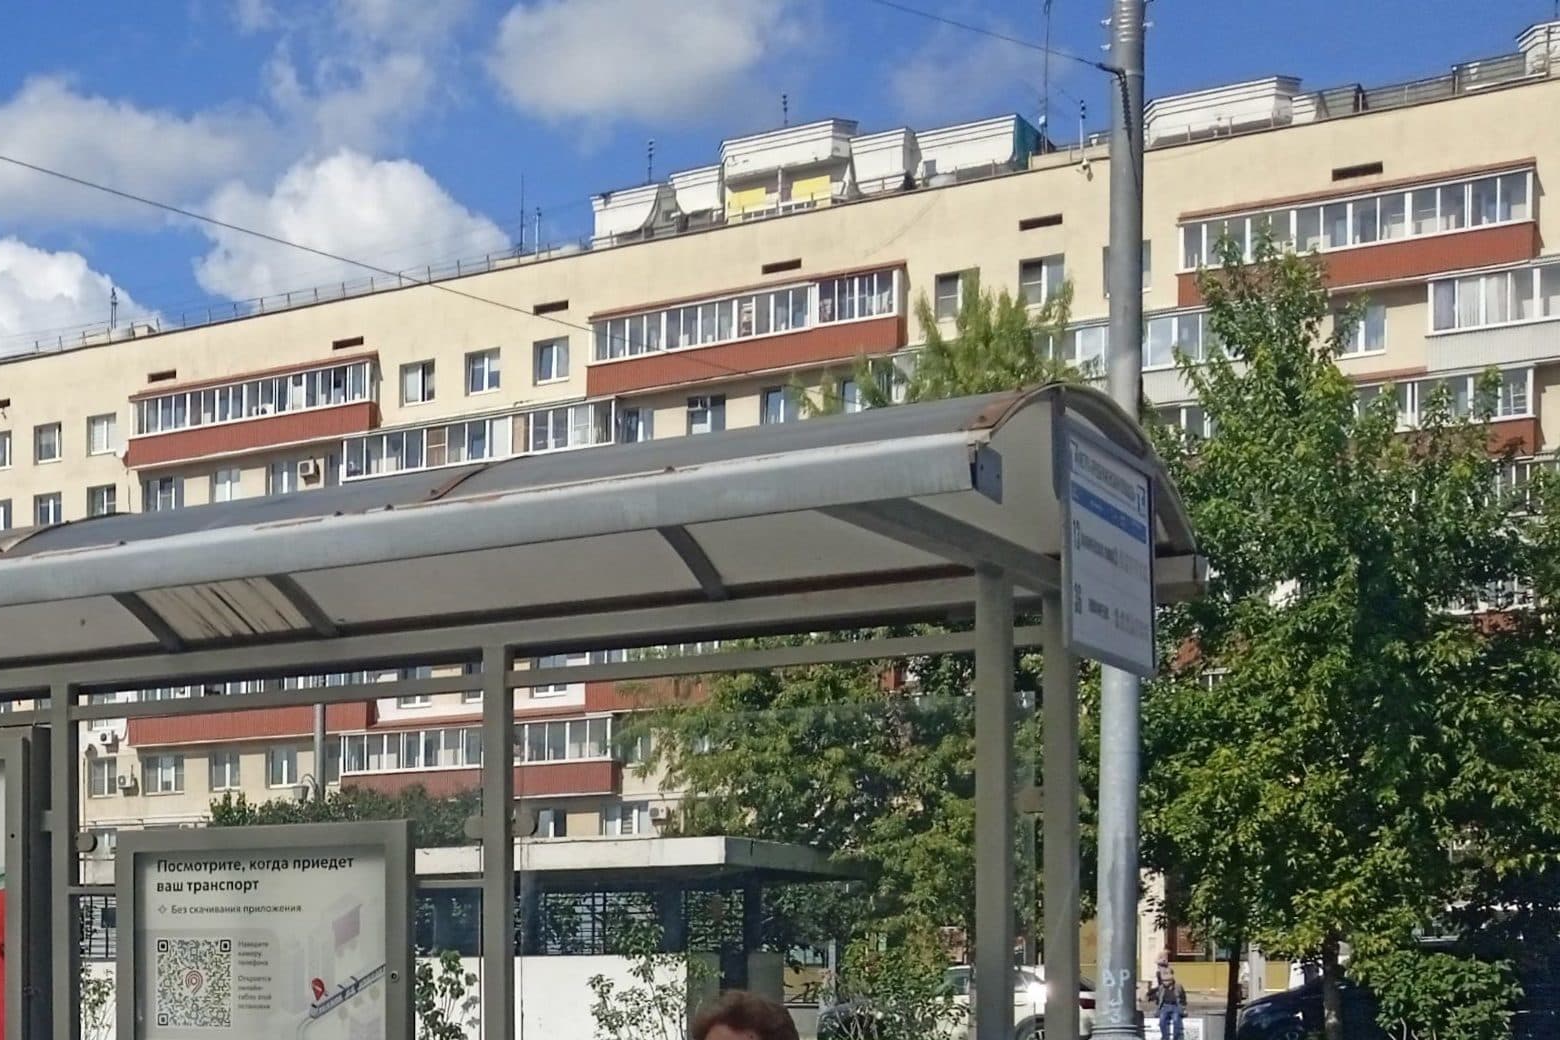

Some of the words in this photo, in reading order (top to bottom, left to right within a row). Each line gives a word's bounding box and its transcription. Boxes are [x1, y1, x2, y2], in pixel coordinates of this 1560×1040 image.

[157, 858, 245, 874] Посмотрите,
[249, 857, 289, 872] когда
[293, 856, 354, 871] приедет
[157, 880, 184, 892] ваш
[187, 878, 259, 894] транспорт
[171, 904, 187, 914] Без
[189, 905, 241, 914] скачивания
[243, 904, 302, 915] приложения
